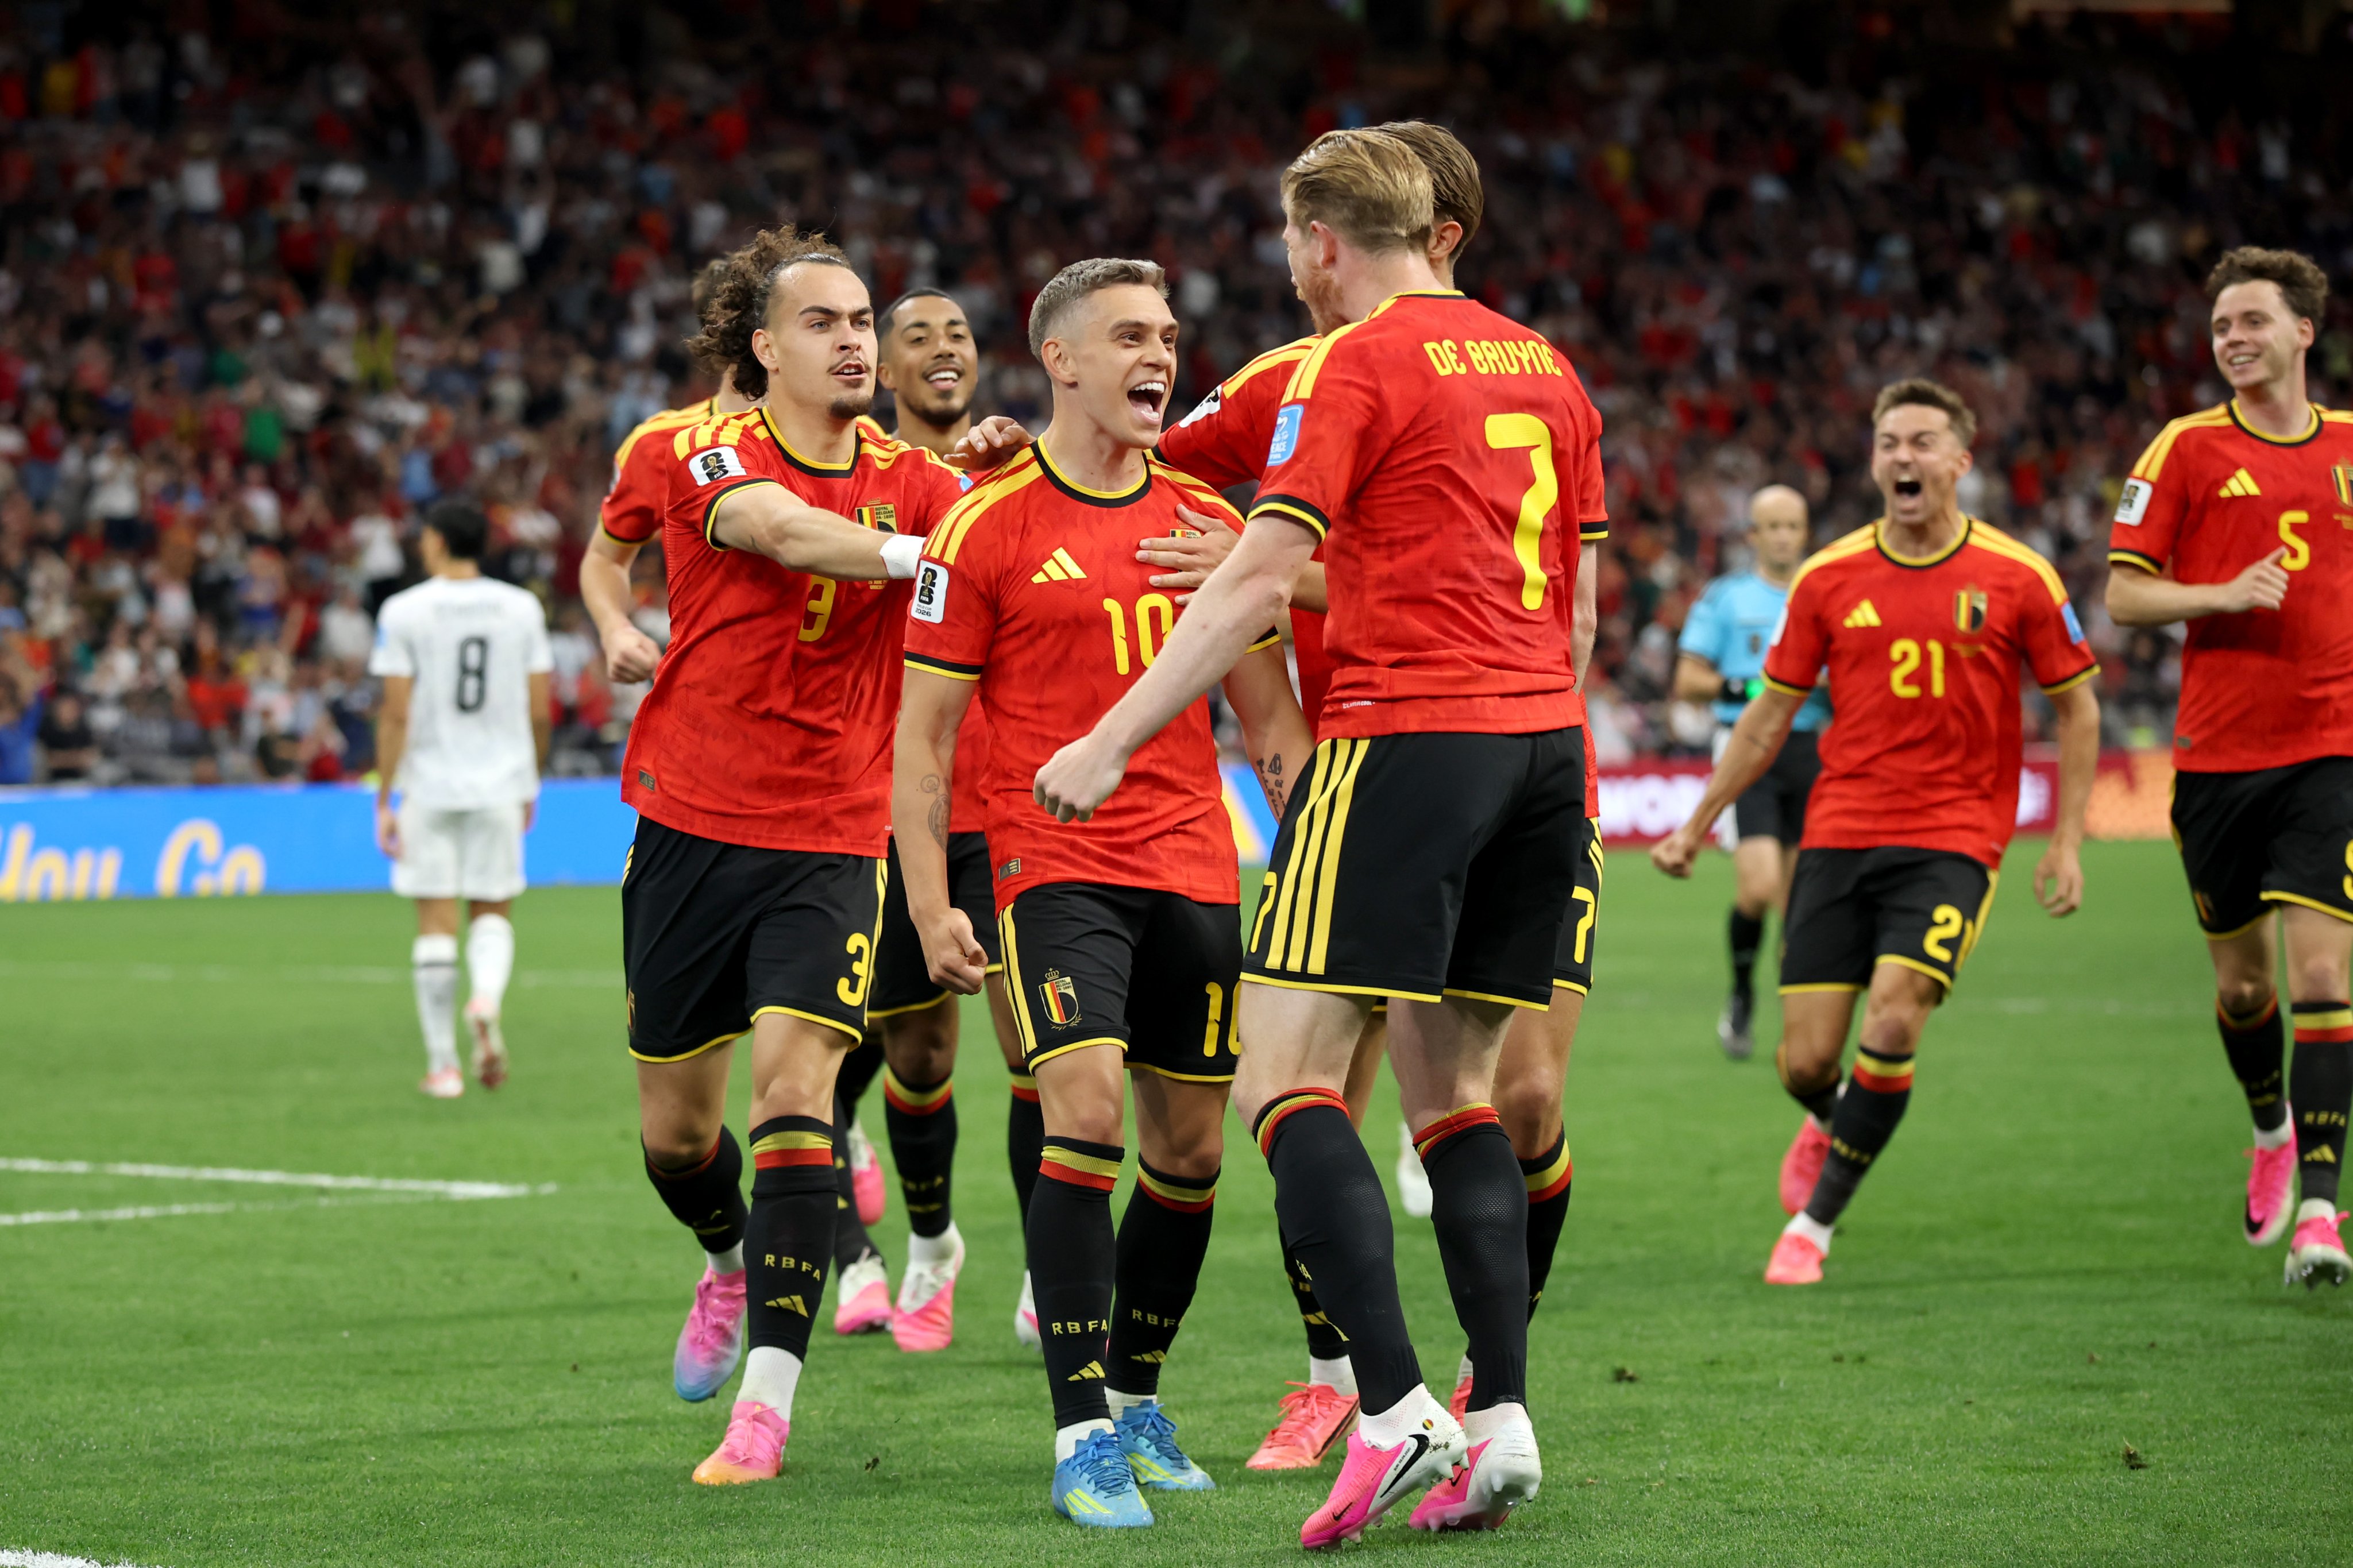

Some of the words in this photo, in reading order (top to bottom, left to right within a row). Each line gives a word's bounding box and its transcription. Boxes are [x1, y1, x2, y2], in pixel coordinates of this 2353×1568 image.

[1423, 339, 1467, 376] DE
[1464, 340, 1563, 377] BRUYNE
[714, 470, 724, 479] FIFA
[1270, 441, 1287, 453] EACE
[1484, 412, 1558, 611] 7
[2278, 510, 2310, 571] 5
[798, 574, 837, 642] 3
[1102, 593, 1173, 675] 10
[456, 636, 488, 713] 8
[1889, 638, 1946, 698] 21
[154, 818, 266, 897] Go
[1250, 871, 1277, 953] 7
[836, 932, 870, 1007] 3
[765, 1253, 820, 1281] RBFA
[1052, 1319, 1108, 1335] RBFA
